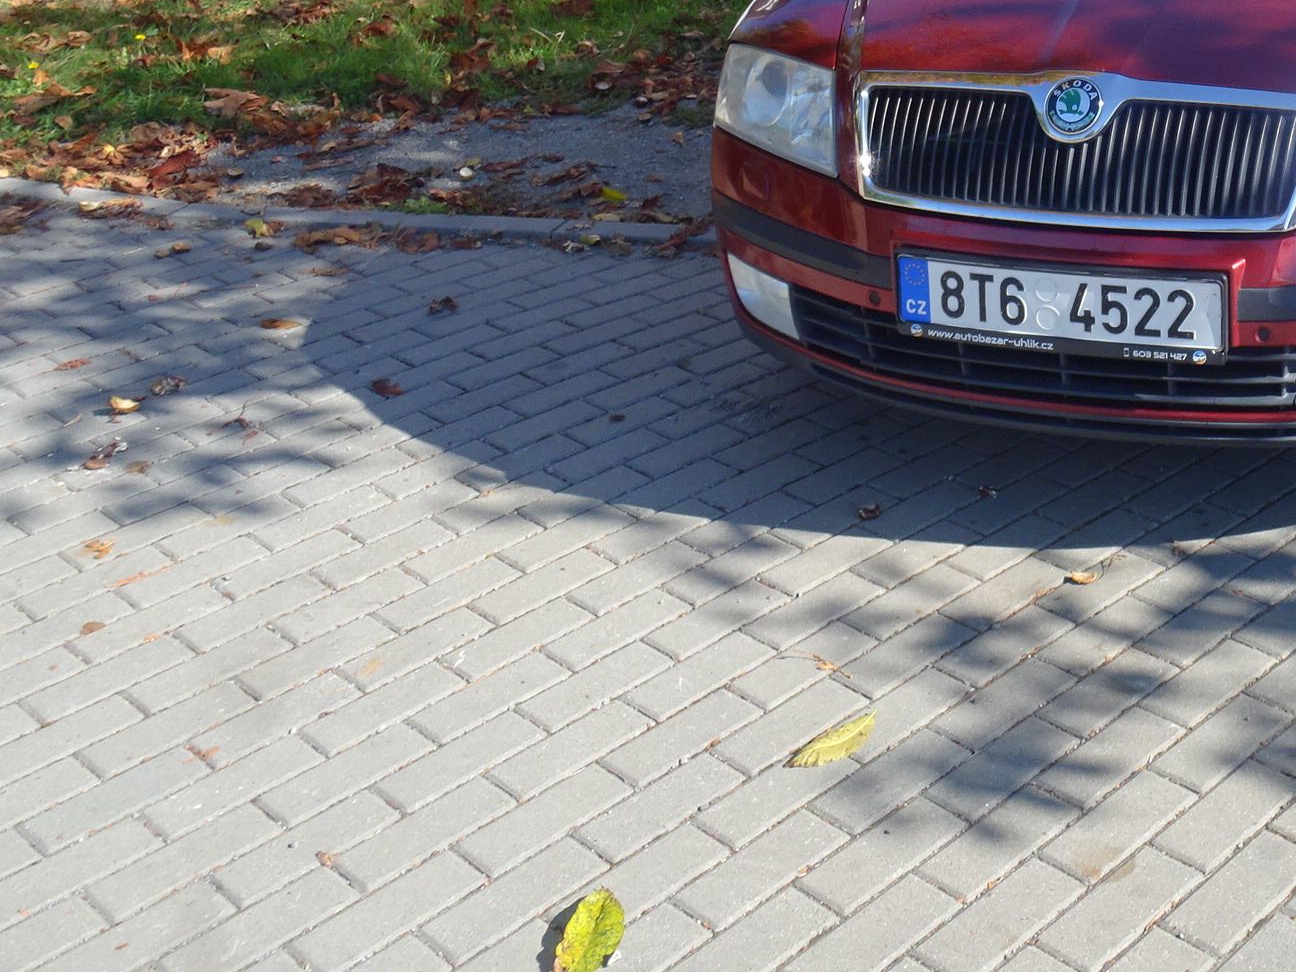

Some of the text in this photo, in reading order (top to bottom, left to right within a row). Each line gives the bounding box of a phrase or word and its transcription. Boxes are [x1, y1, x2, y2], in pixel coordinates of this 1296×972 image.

[906, 299, 928, 316] CZ
[940, 270, 1196, 340] 8T6 4522
[927, 328, 1054, 351] www.autobazar-uhlik.cz
[1132, 349, 1188, 361] 603 521 427
